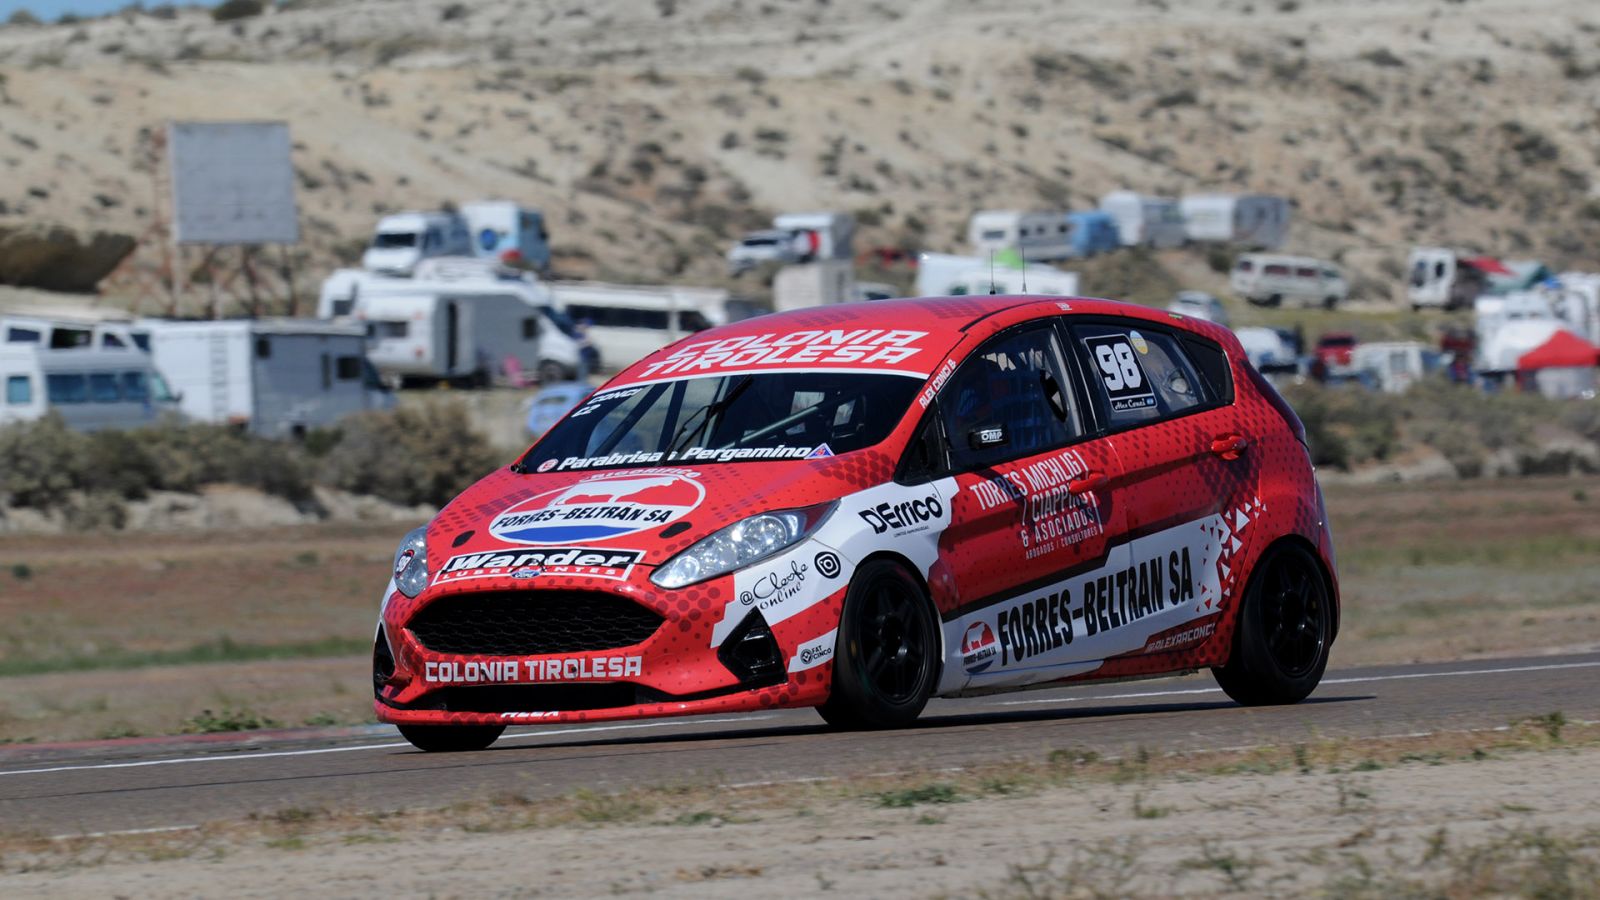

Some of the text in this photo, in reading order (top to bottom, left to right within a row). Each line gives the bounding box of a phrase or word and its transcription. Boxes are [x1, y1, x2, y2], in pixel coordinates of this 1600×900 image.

[666, 330, 930, 360] COLONIA
[637, 345, 924, 378] TIROLESA
[1096, 342, 1141, 391] 98
[919, 386, 936, 409] ALEX
[932, 364, 951, 391] CONCI
[981, 431, 1002, 440] OMP
[680, 445, 812, 462] Pergamino
[969, 449, 1083, 510] TORRES MICHLIG
[643, 509, 674, 523] SA
[1021, 506, 1095, 548] & ASOCIADOS
[446, 550, 631, 572] Wander
[997, 546, 1194, 666] FORRES-BELTRAN SA
[812, 645, 822, 654] FAT
[812, 647, 832, 660] CINCO
[425, 656, 642, 682] COLONIA TIROLESA
